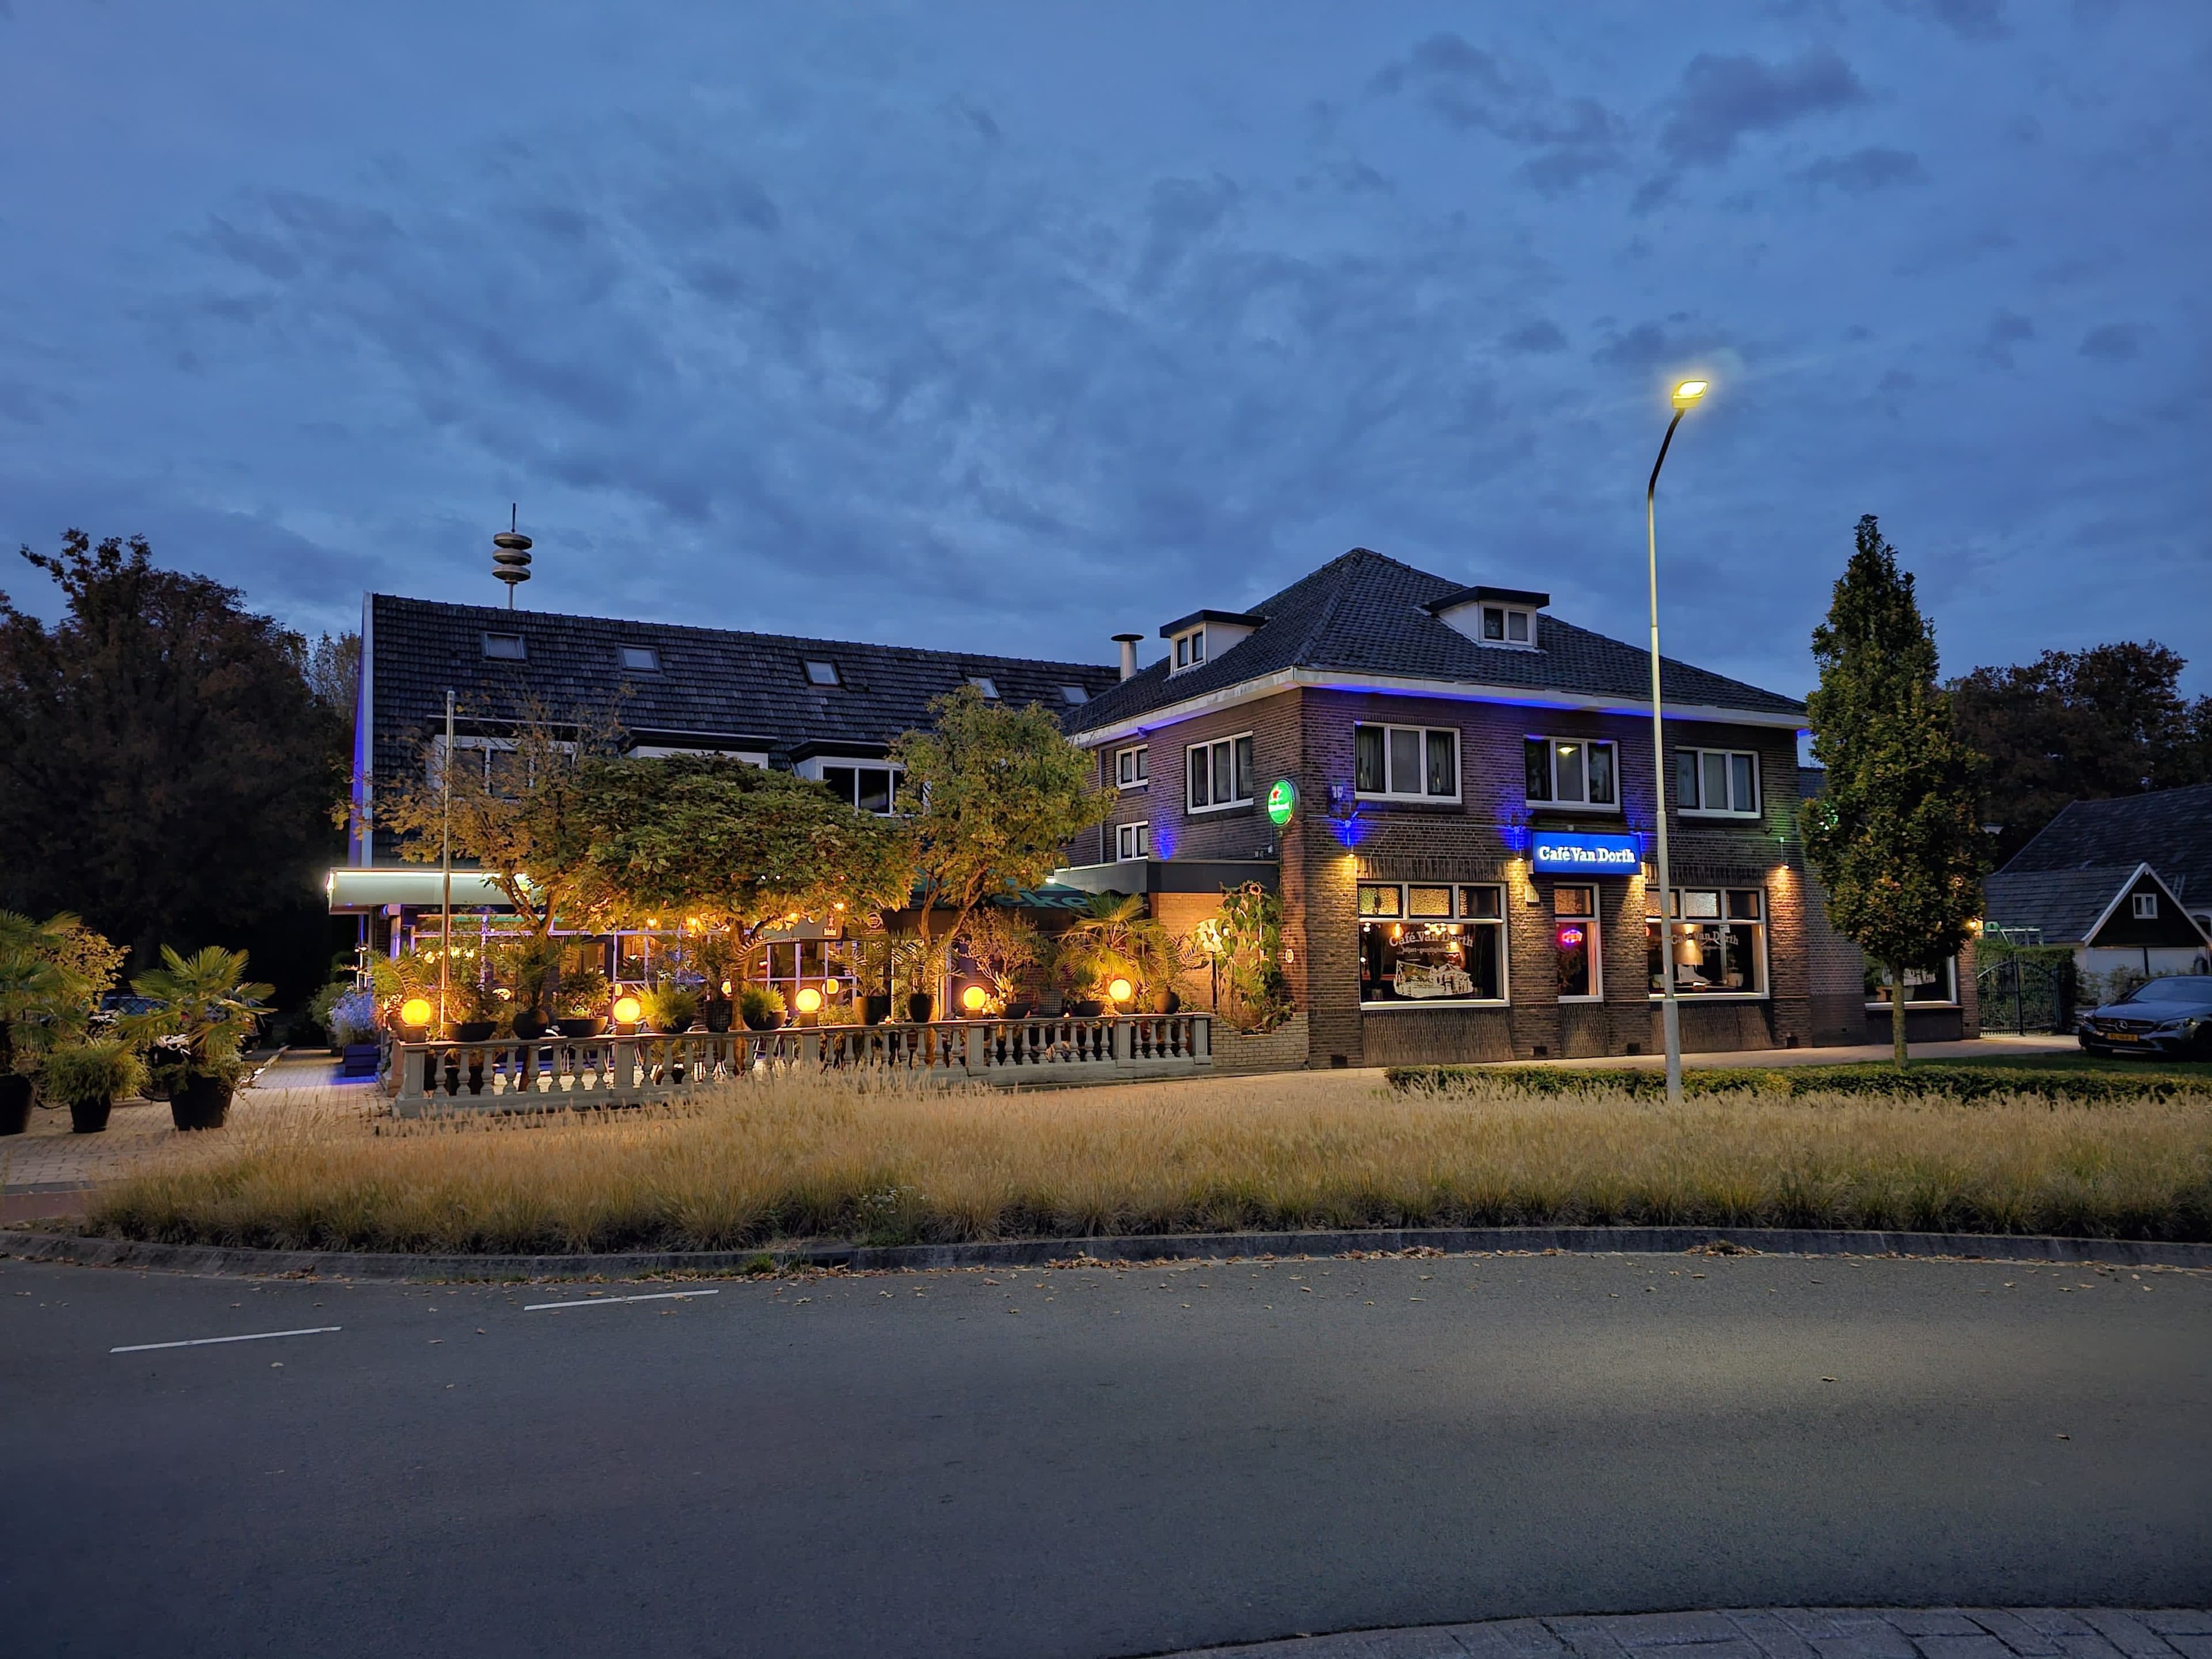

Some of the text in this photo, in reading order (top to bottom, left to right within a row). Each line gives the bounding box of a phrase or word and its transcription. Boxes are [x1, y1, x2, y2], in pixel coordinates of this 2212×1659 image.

[1539, 846, 1636, 863] Café Van Dorth
[1389, 930, 1416, 946] Café
[1416, 931, 1439, 942] Van
